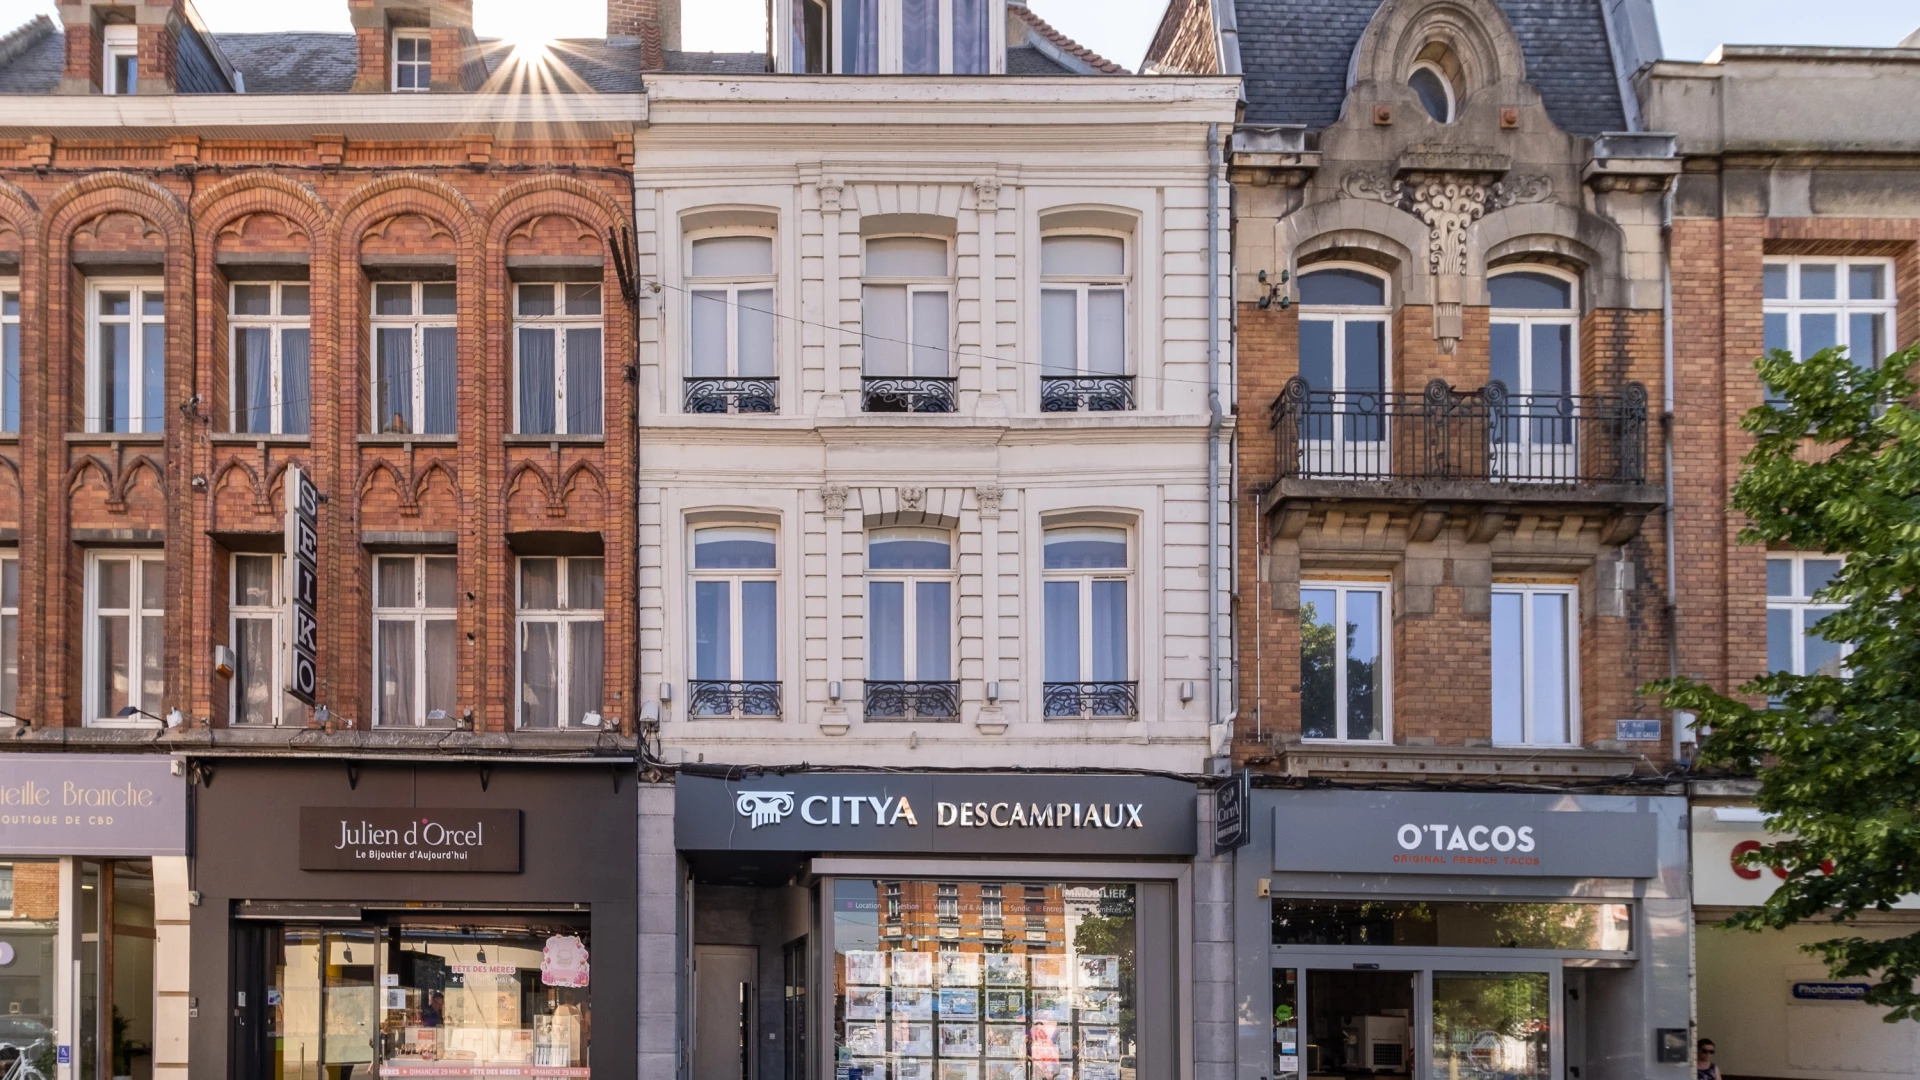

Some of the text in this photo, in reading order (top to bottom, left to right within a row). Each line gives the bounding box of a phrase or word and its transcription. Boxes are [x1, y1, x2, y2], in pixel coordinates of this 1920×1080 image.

[299, 479, 318, 694] SEIKO
[0, 780, 153, 807] ieille Branche
[800, 796, 1144, 828] CITYA DESCAMPIAUX
[1, 815, 114, 826] OUTIQUE DE CBD
[335, 820, 399, 850] Julien
[1397, 823, 1536, 853] O'TACOS
[355, 850, 468, 861] Le Bijoutier d'Aujourd'hui
[1392, 854, 1540, 866] ORIGINAL FRENCH TACOS
[855, 902, 882, 910] Location
[1010, 904, 1032, 913] Syndic
[453, 965, 471, 973] FÊTE
[489, 965, 515, 974] MÈRES
[409, 1068, 440, 1076] DIMANCHE
[449, 1068, 460, 1076] MAI
[469, 1067, 485, 1076] FÊTE
[486, 1067, 498, 1076] DES
[531, 1068, 560, 1077] DIMANCHE
[570, 1069, 582, 1077] MAI
